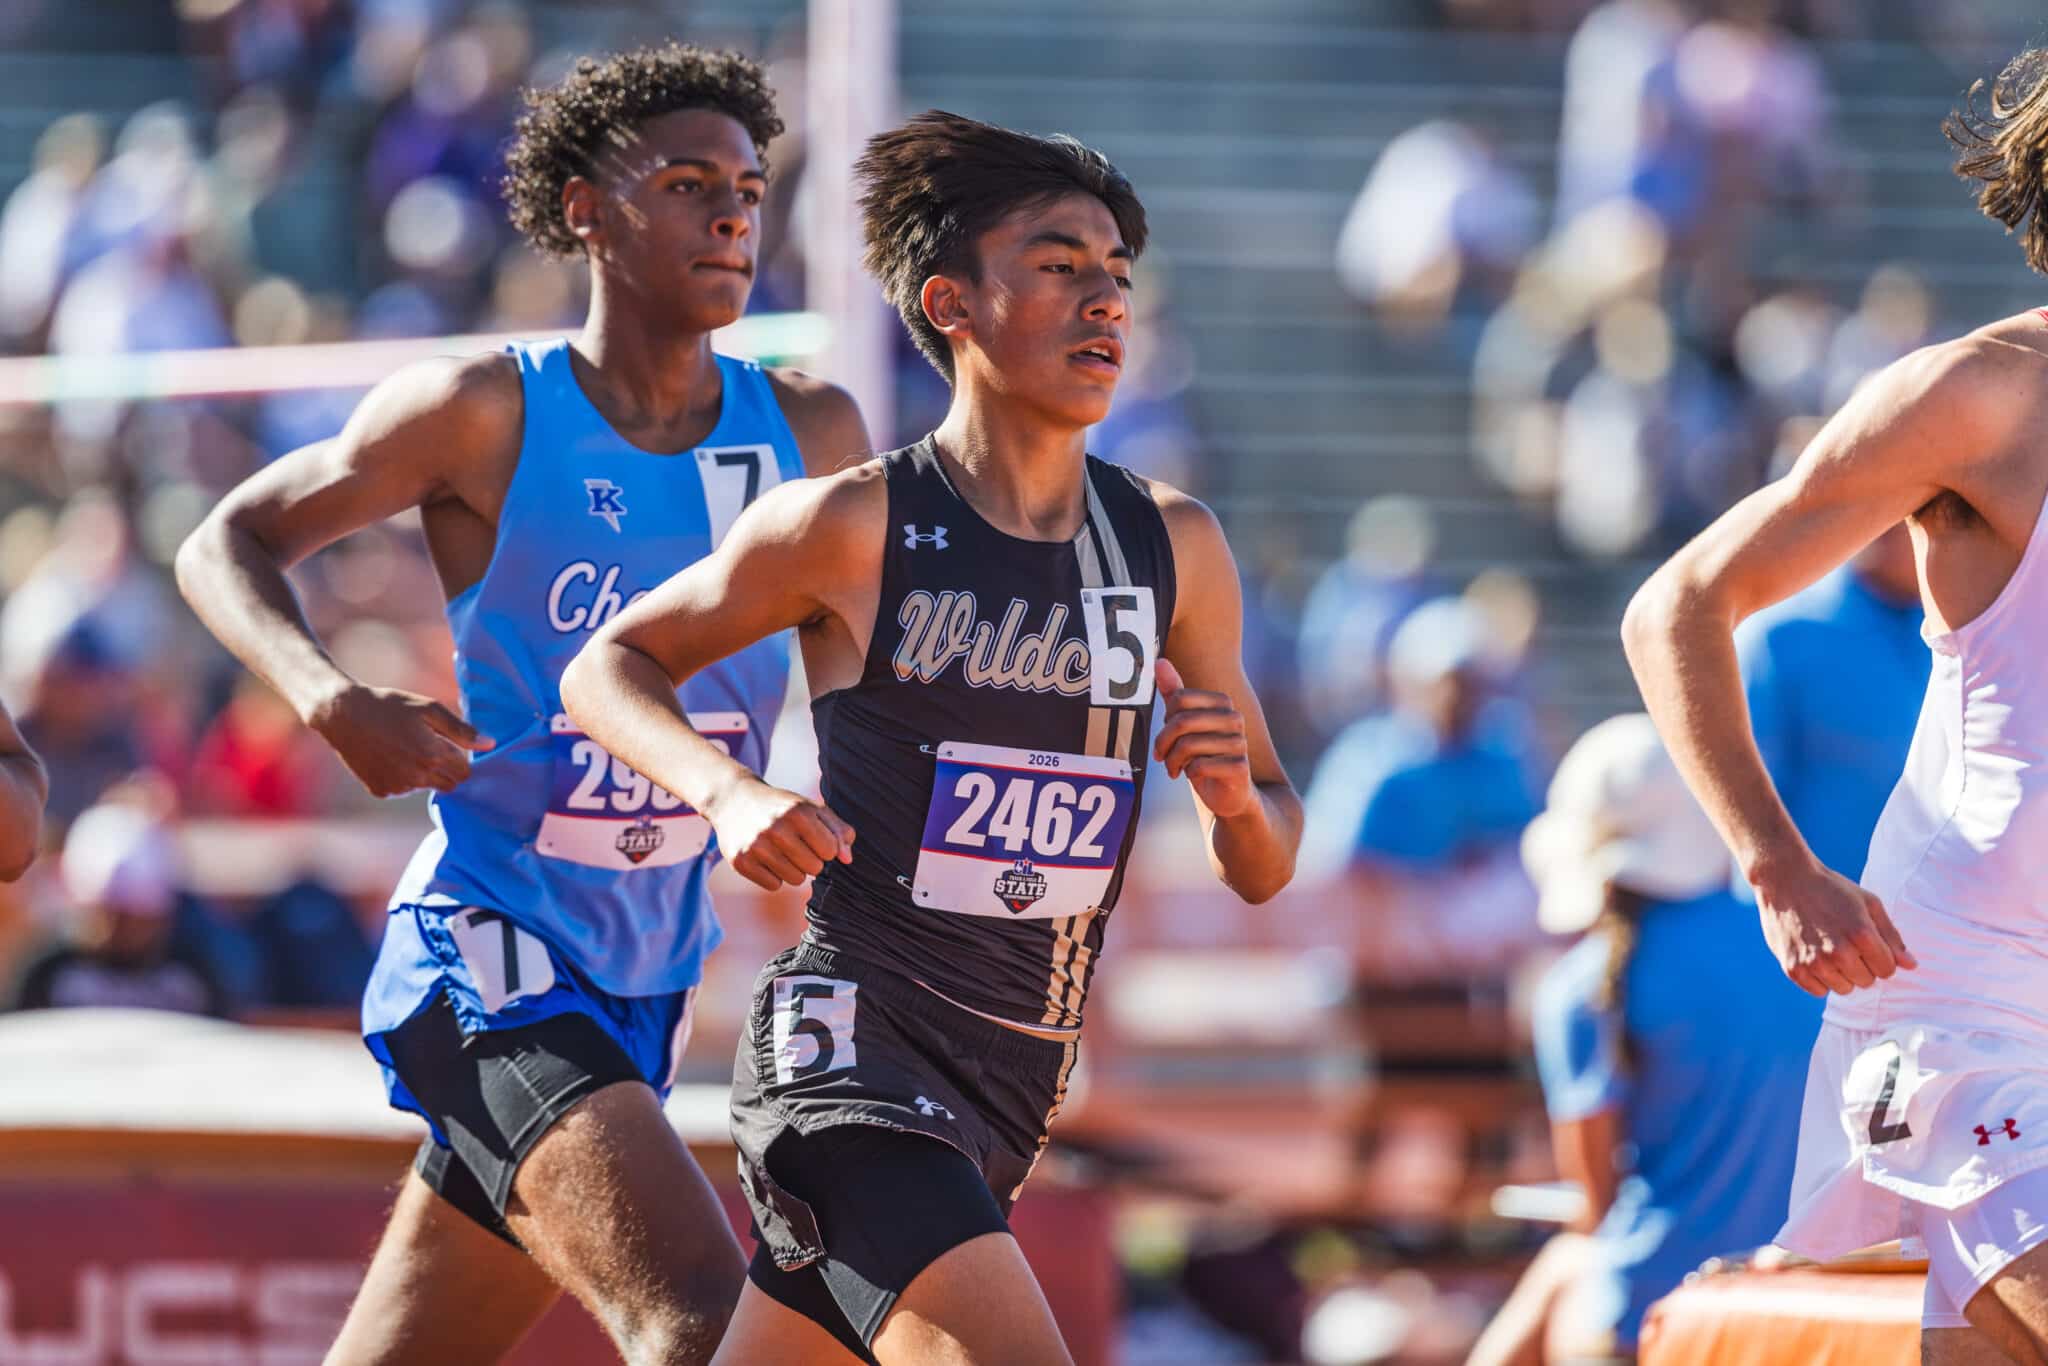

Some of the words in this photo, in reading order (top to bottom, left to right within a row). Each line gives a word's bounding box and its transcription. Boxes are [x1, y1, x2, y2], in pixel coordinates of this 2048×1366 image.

[591, 487, 624, 512] K
[714, 450, 761, 512] 7
[546, 558, 652, 633] Ch
[892, 590, 1091, 697] Wildc
[1101, 594, 1145, 700] 5
[566, 739, 730, 812] 29
[1027, 753, 1060, 767] 2026
[944, 771, 1116, 859] 2462
[994, 879, 1047, 897] STATE
[467, 910, 521, 995] 7
[789, 983, 835, 1080] 5
